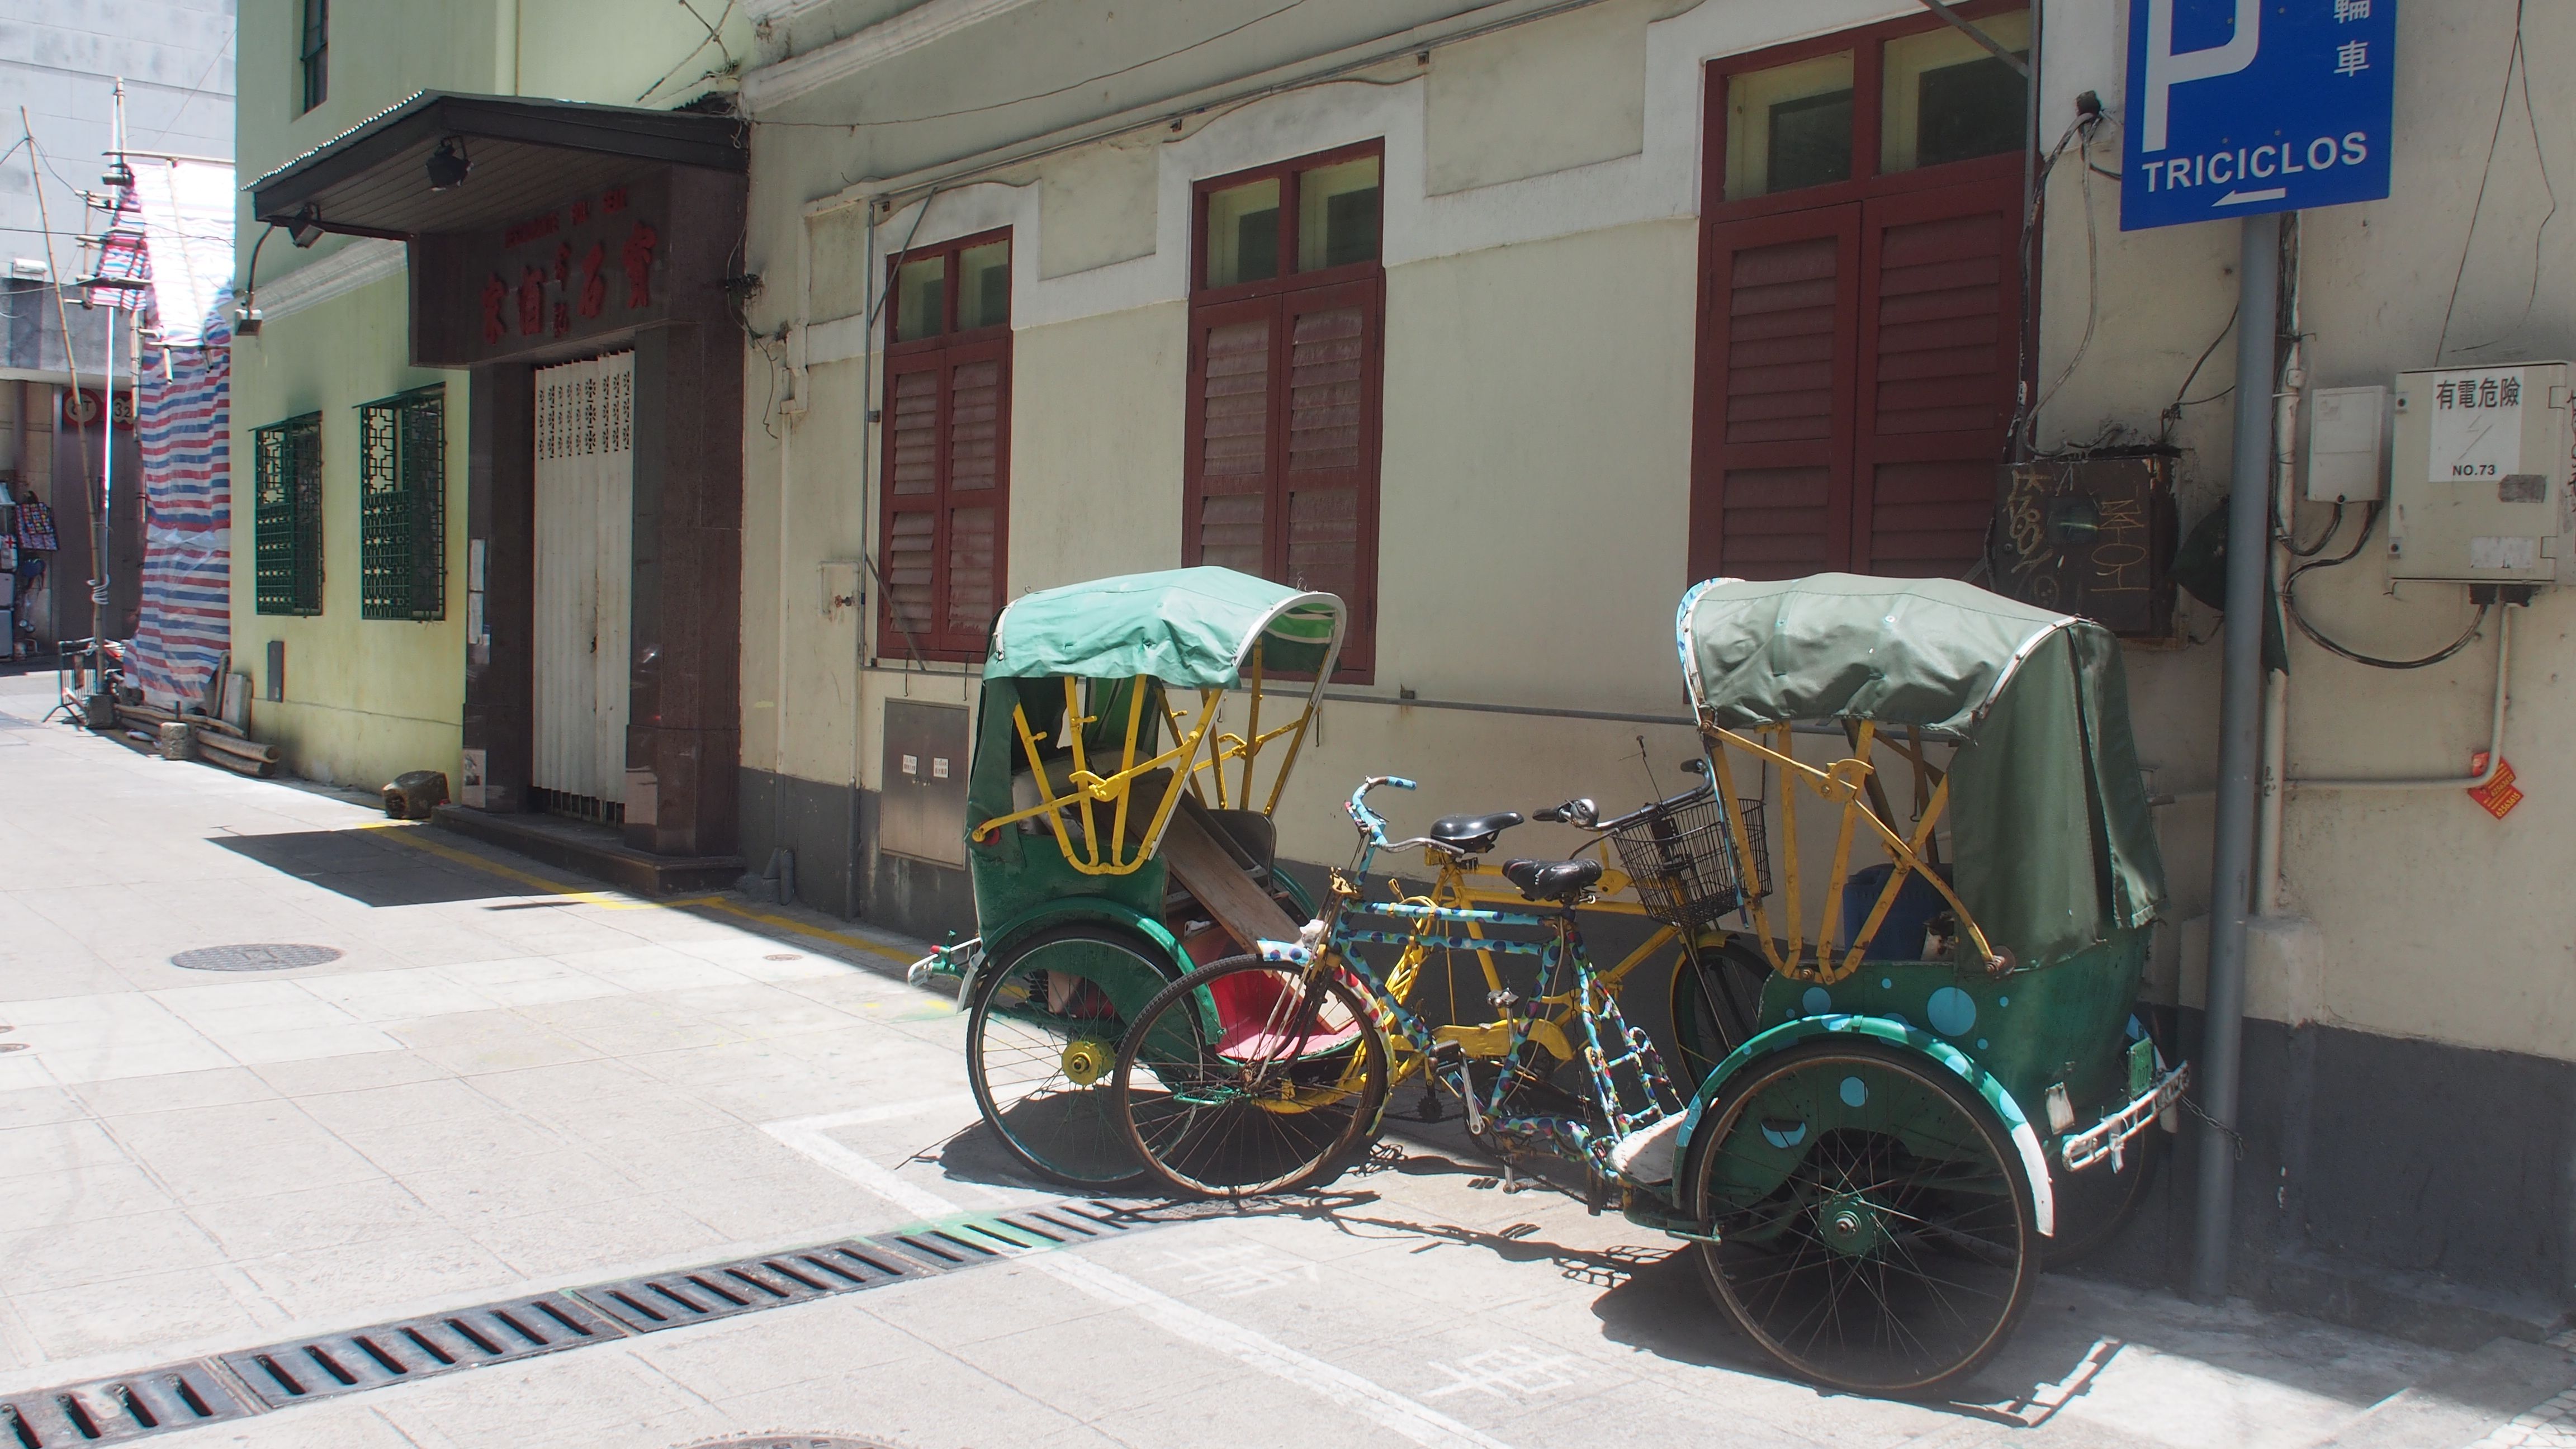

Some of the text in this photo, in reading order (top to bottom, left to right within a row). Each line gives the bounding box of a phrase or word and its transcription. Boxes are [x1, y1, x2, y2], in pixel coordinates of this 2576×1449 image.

[2142, 0, 2262, 153] P
[2142, 131, 2368, 193] TRICICLOS
[2436, 376, 2520, 410] 有電危險
[2452, 465, 2496, 476] NO.73
